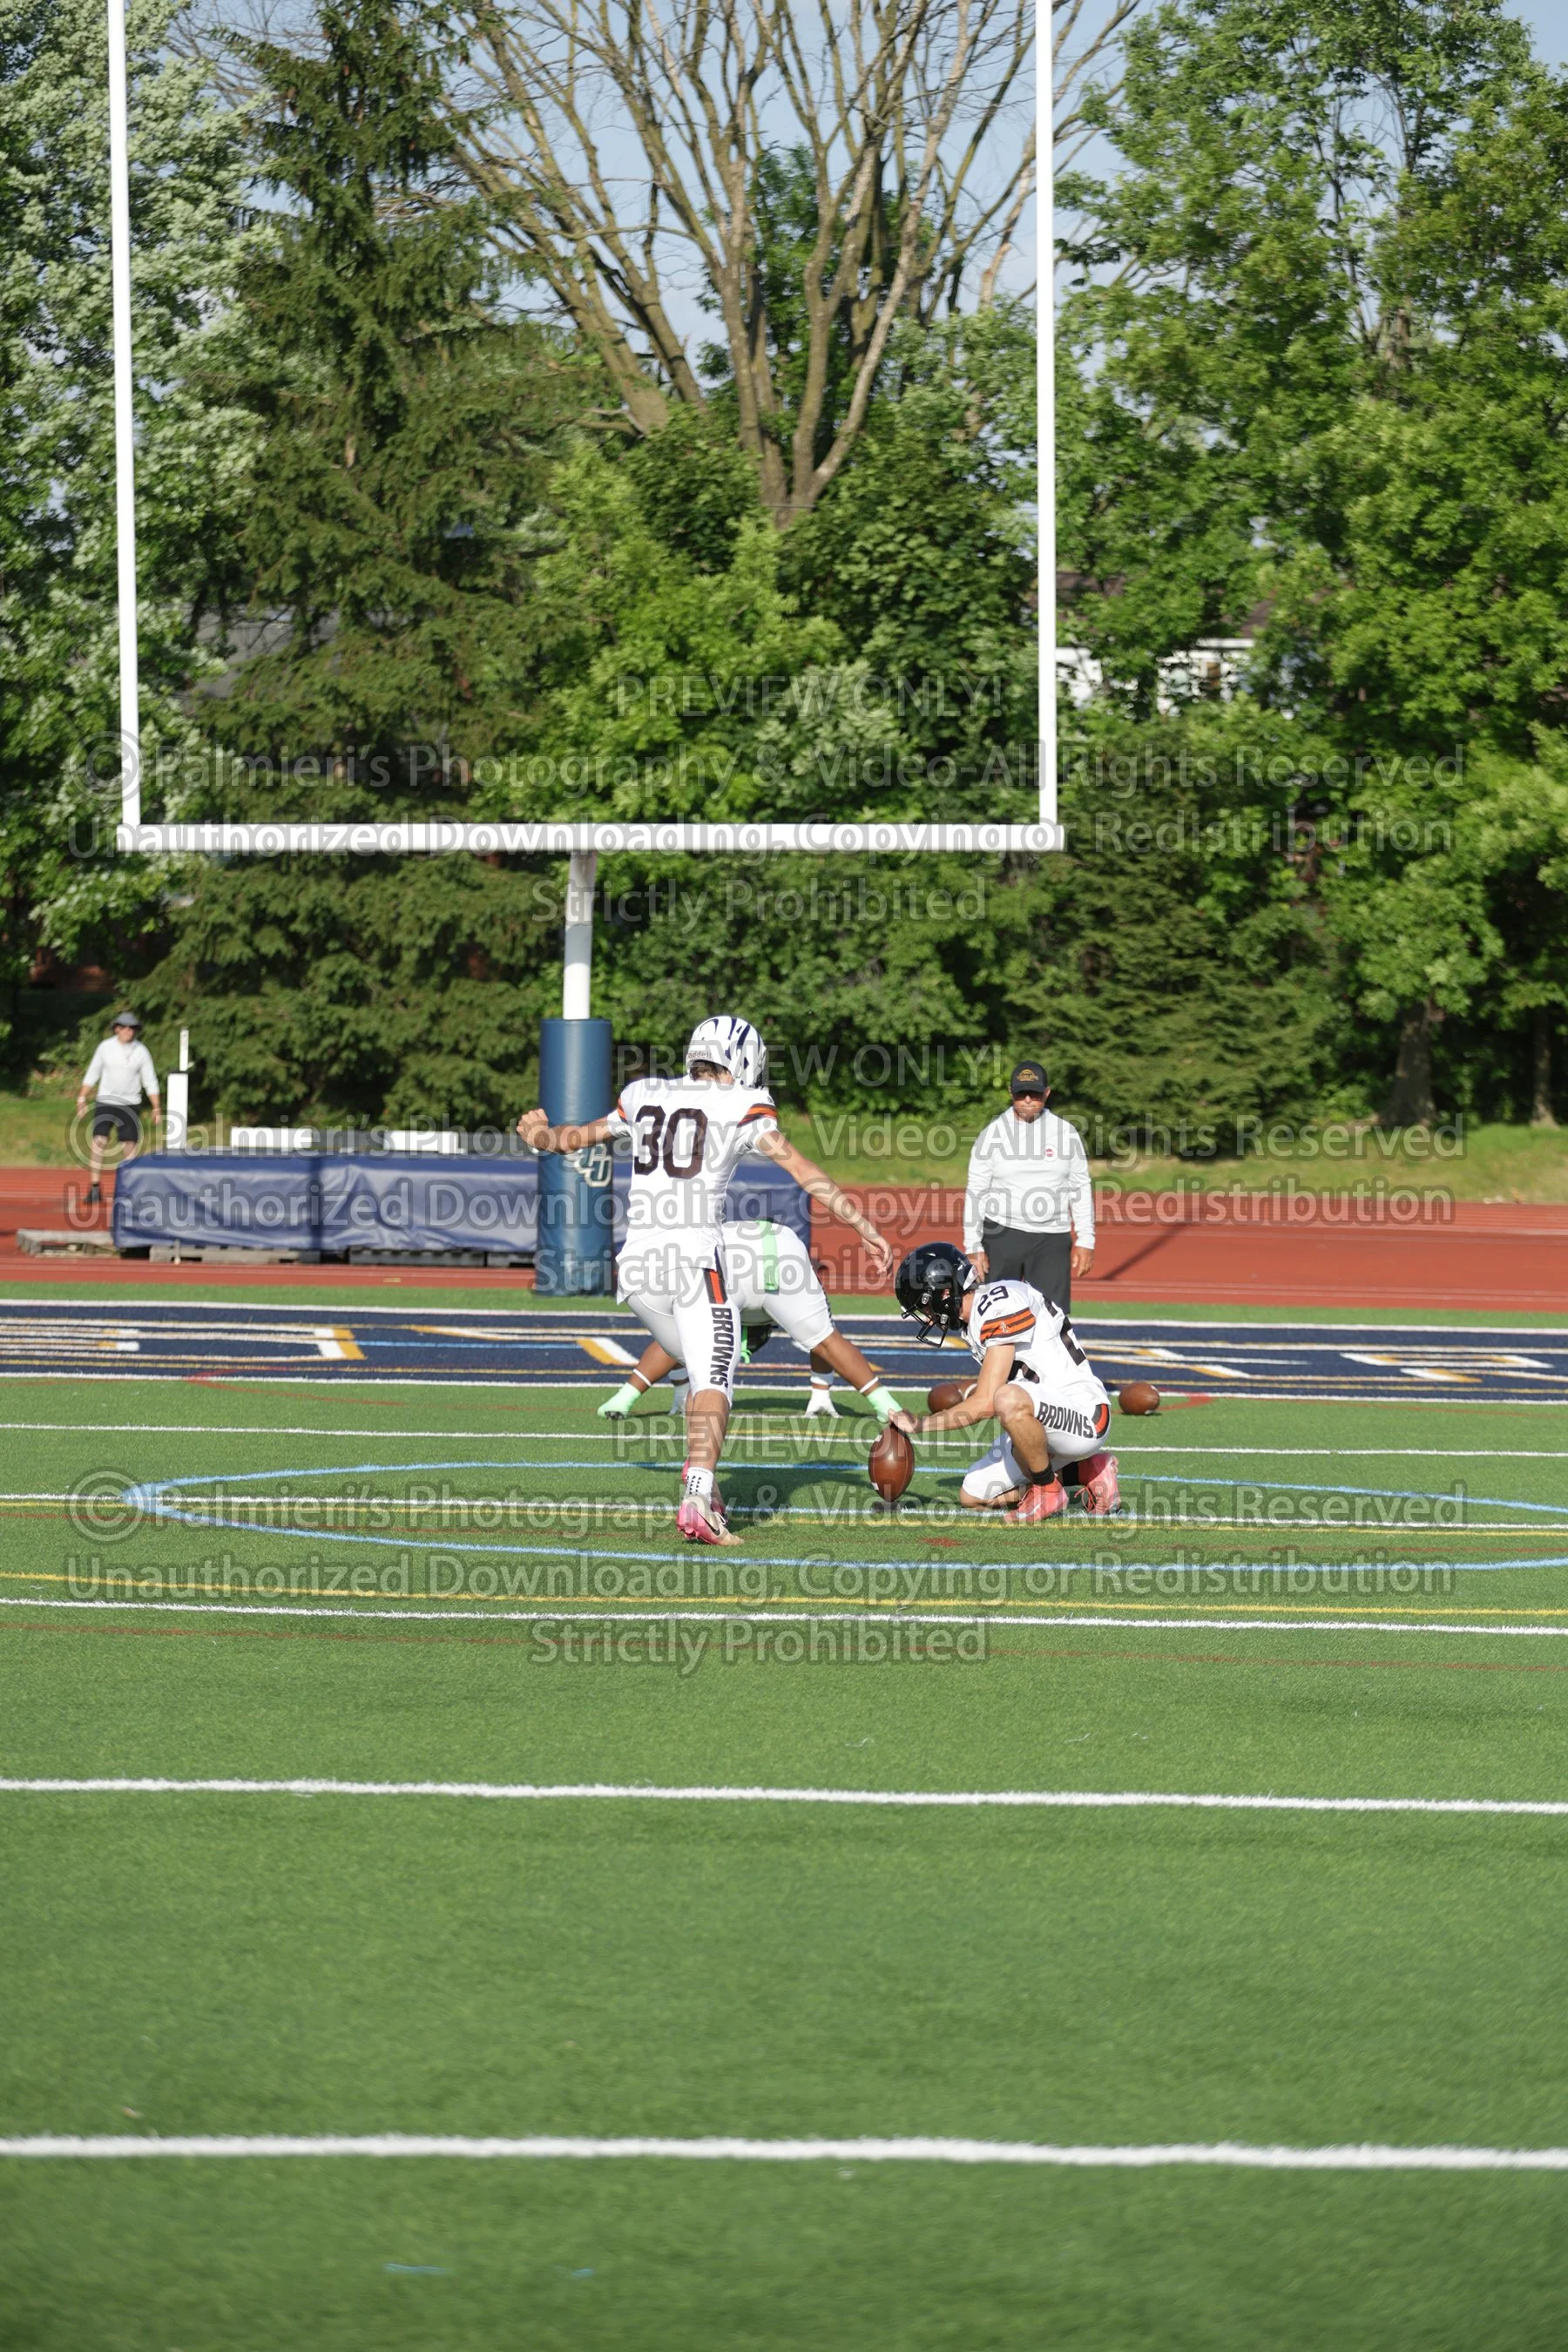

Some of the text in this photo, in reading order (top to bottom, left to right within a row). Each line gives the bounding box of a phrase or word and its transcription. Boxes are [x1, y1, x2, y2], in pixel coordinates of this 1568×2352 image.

[634, 1105, 708, 1179] 30
[977, 1285, 1010, 1317] 29
[709, 1307, 734, 1389] BROWNS
[1037, 1401, 1094, 1439] BROWNS
